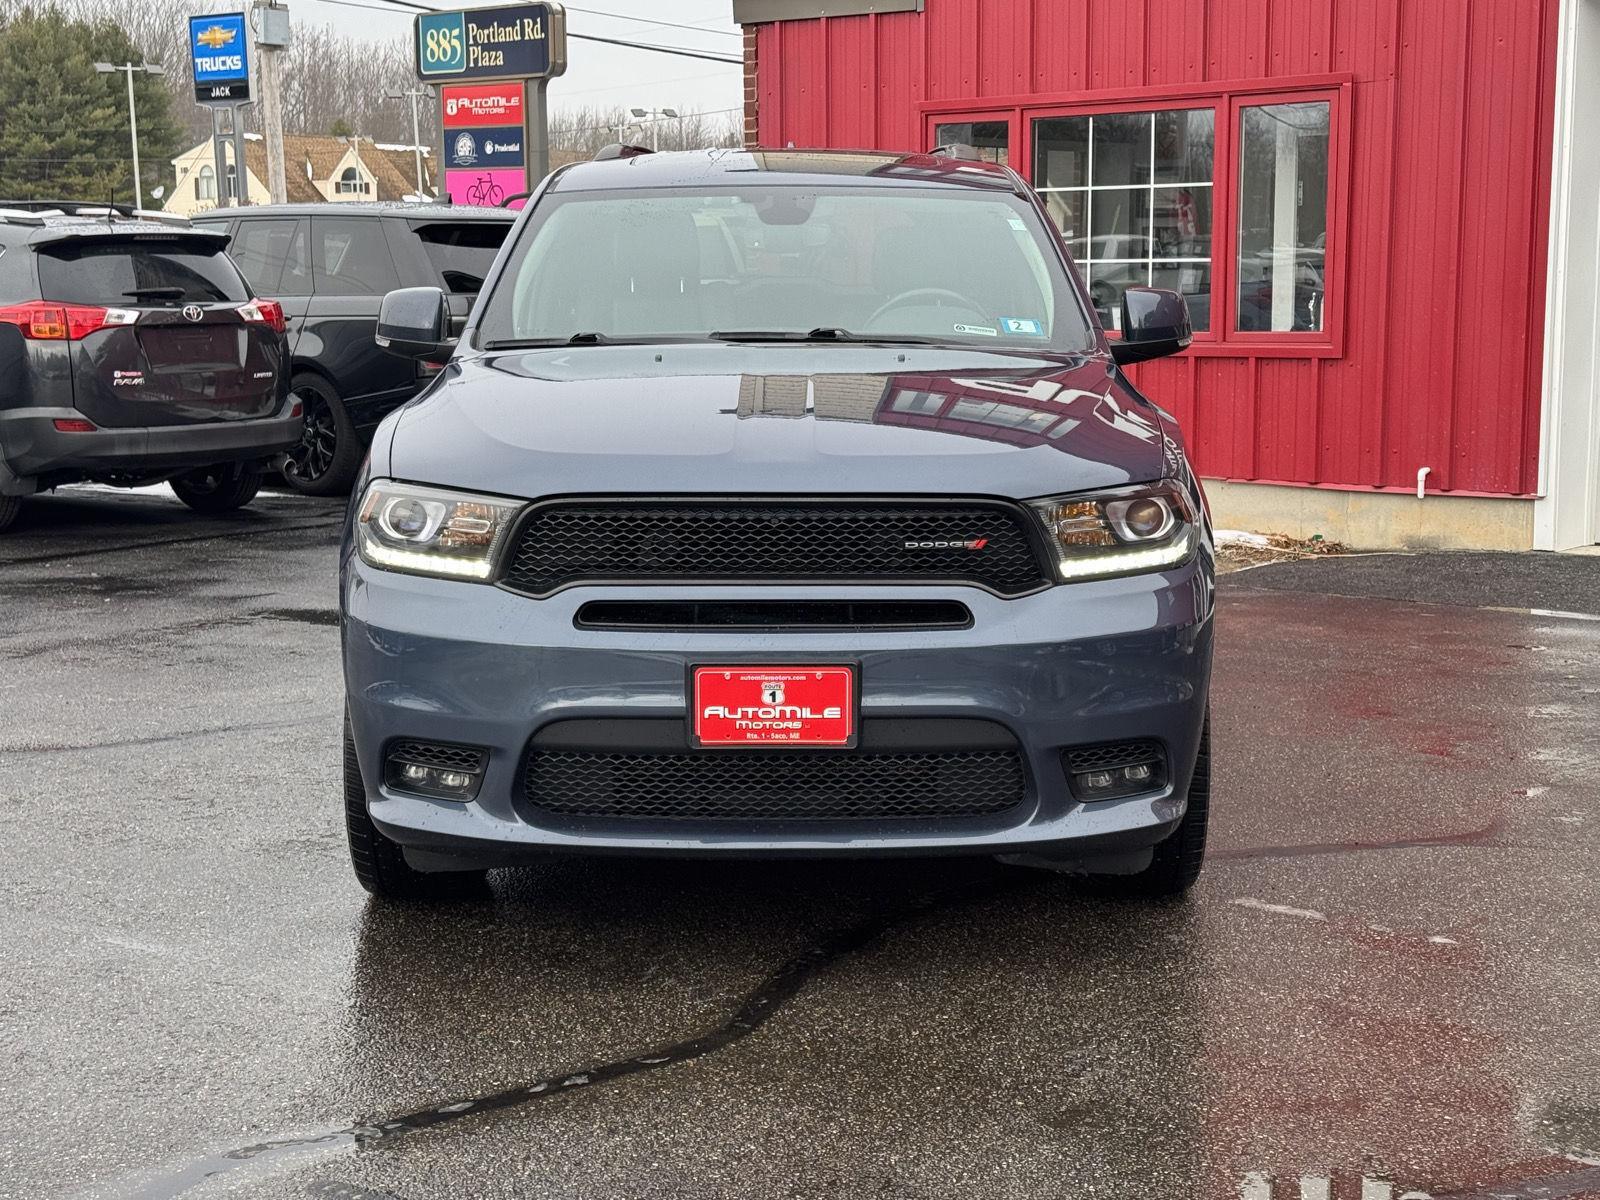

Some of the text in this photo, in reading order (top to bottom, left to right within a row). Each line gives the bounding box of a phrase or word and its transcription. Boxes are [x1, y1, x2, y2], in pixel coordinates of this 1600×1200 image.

[468, 17, 545, 45] Portland Rd.
[426, 28, 462, 64] 885
[469, 46, 504, 68] Plaza
[195, 55, 242, 73] TRUCKS
[211, 86, 231, 97] JACK
[472, 107, 505, 115] MOTORS
[494, 143, 520, 152] Prudential
[1012, 321, 1023, 331] 2
[904, 541, 975, 549] DODGE
[769, 690, 776, 703] 1
[703, 705, 841, 719] AUTOMILE
[736, 720, 803, 729] MOTORS
